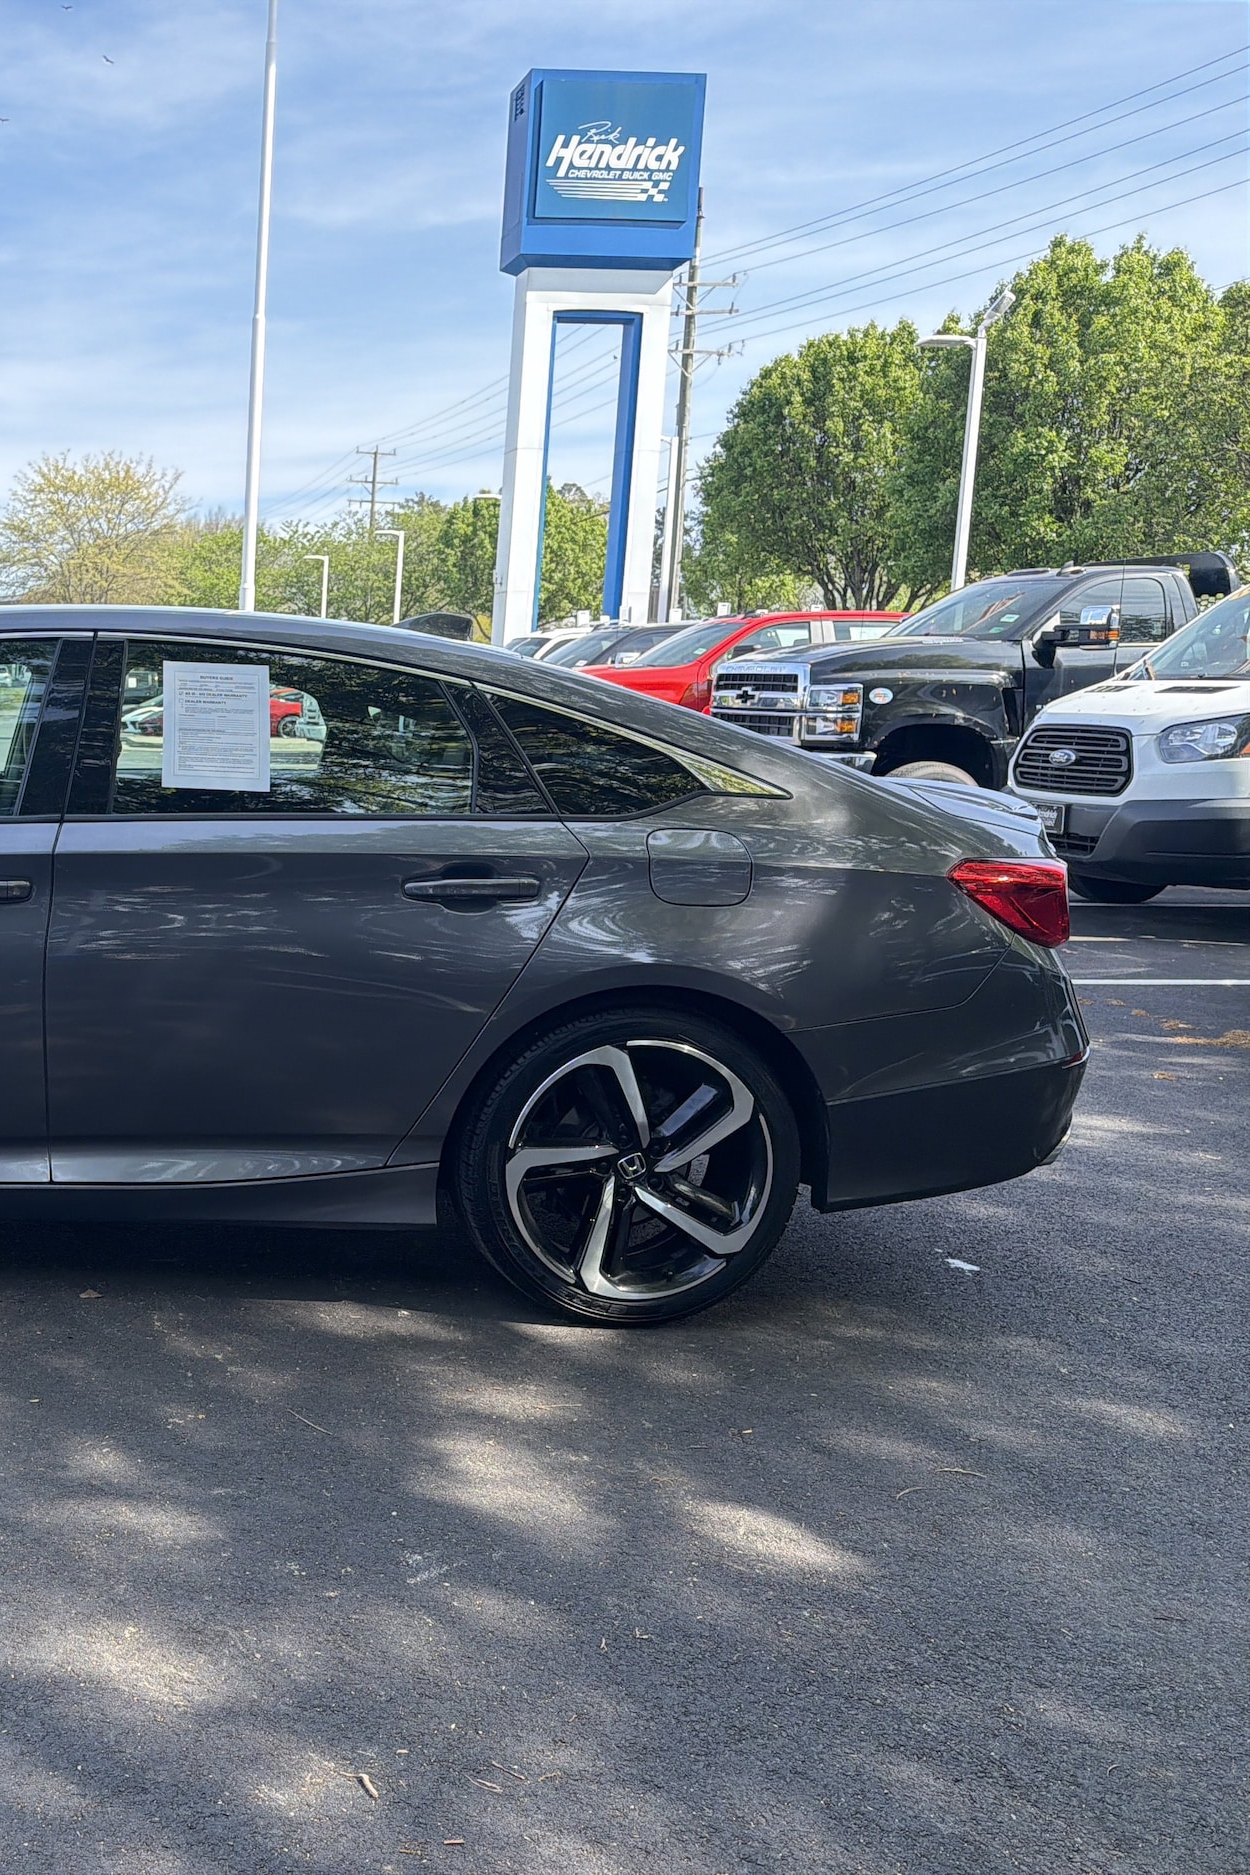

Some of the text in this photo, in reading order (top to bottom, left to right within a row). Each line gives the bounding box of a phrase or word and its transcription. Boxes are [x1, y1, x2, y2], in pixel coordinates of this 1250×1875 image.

[546, 135, 685, 177] Hendrick
[568, 169, 674, 181] CHEVROLET BUICK GMC
